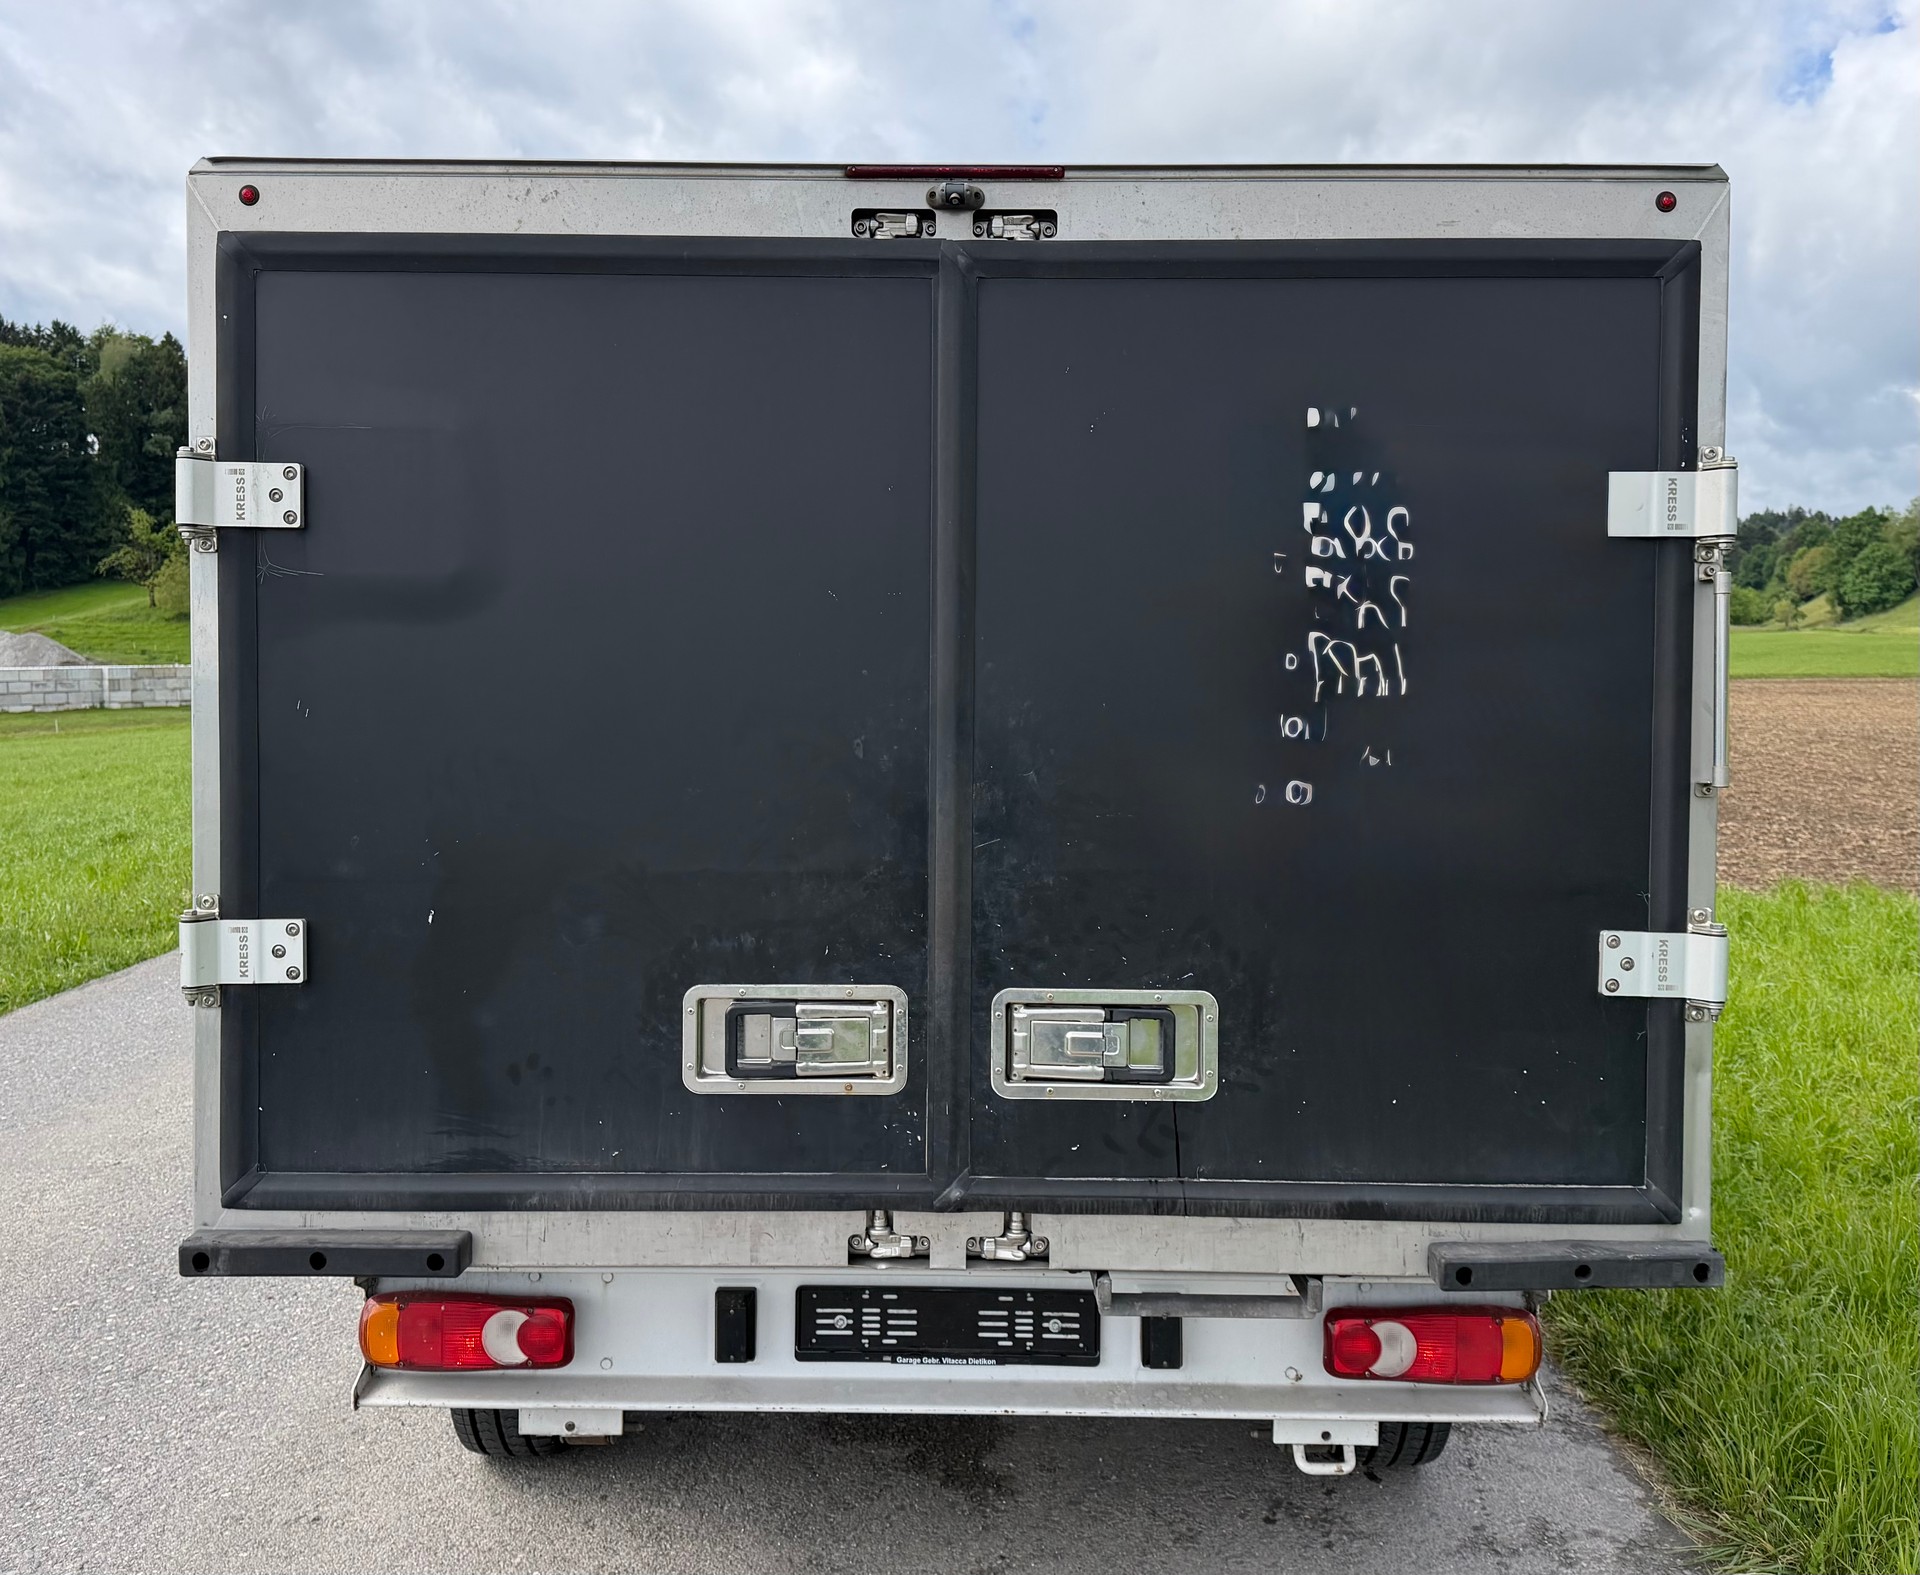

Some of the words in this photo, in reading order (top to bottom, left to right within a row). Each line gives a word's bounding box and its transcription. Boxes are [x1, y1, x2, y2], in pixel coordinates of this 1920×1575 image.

[236, 477, 245, 521] KRESS
[1667, 478, 1678, 522] KRESS
[239, 935, 249, 978] KRESS
[1658, 939, 1669, 983] KRESS
[896, 1356, 921, 1365] Garage
[922, 1356, 940, 1364] Gebr.
[941, 1356, 967, 1364] Vitacca
[968, 1357, 997, 1365] Dietikon
